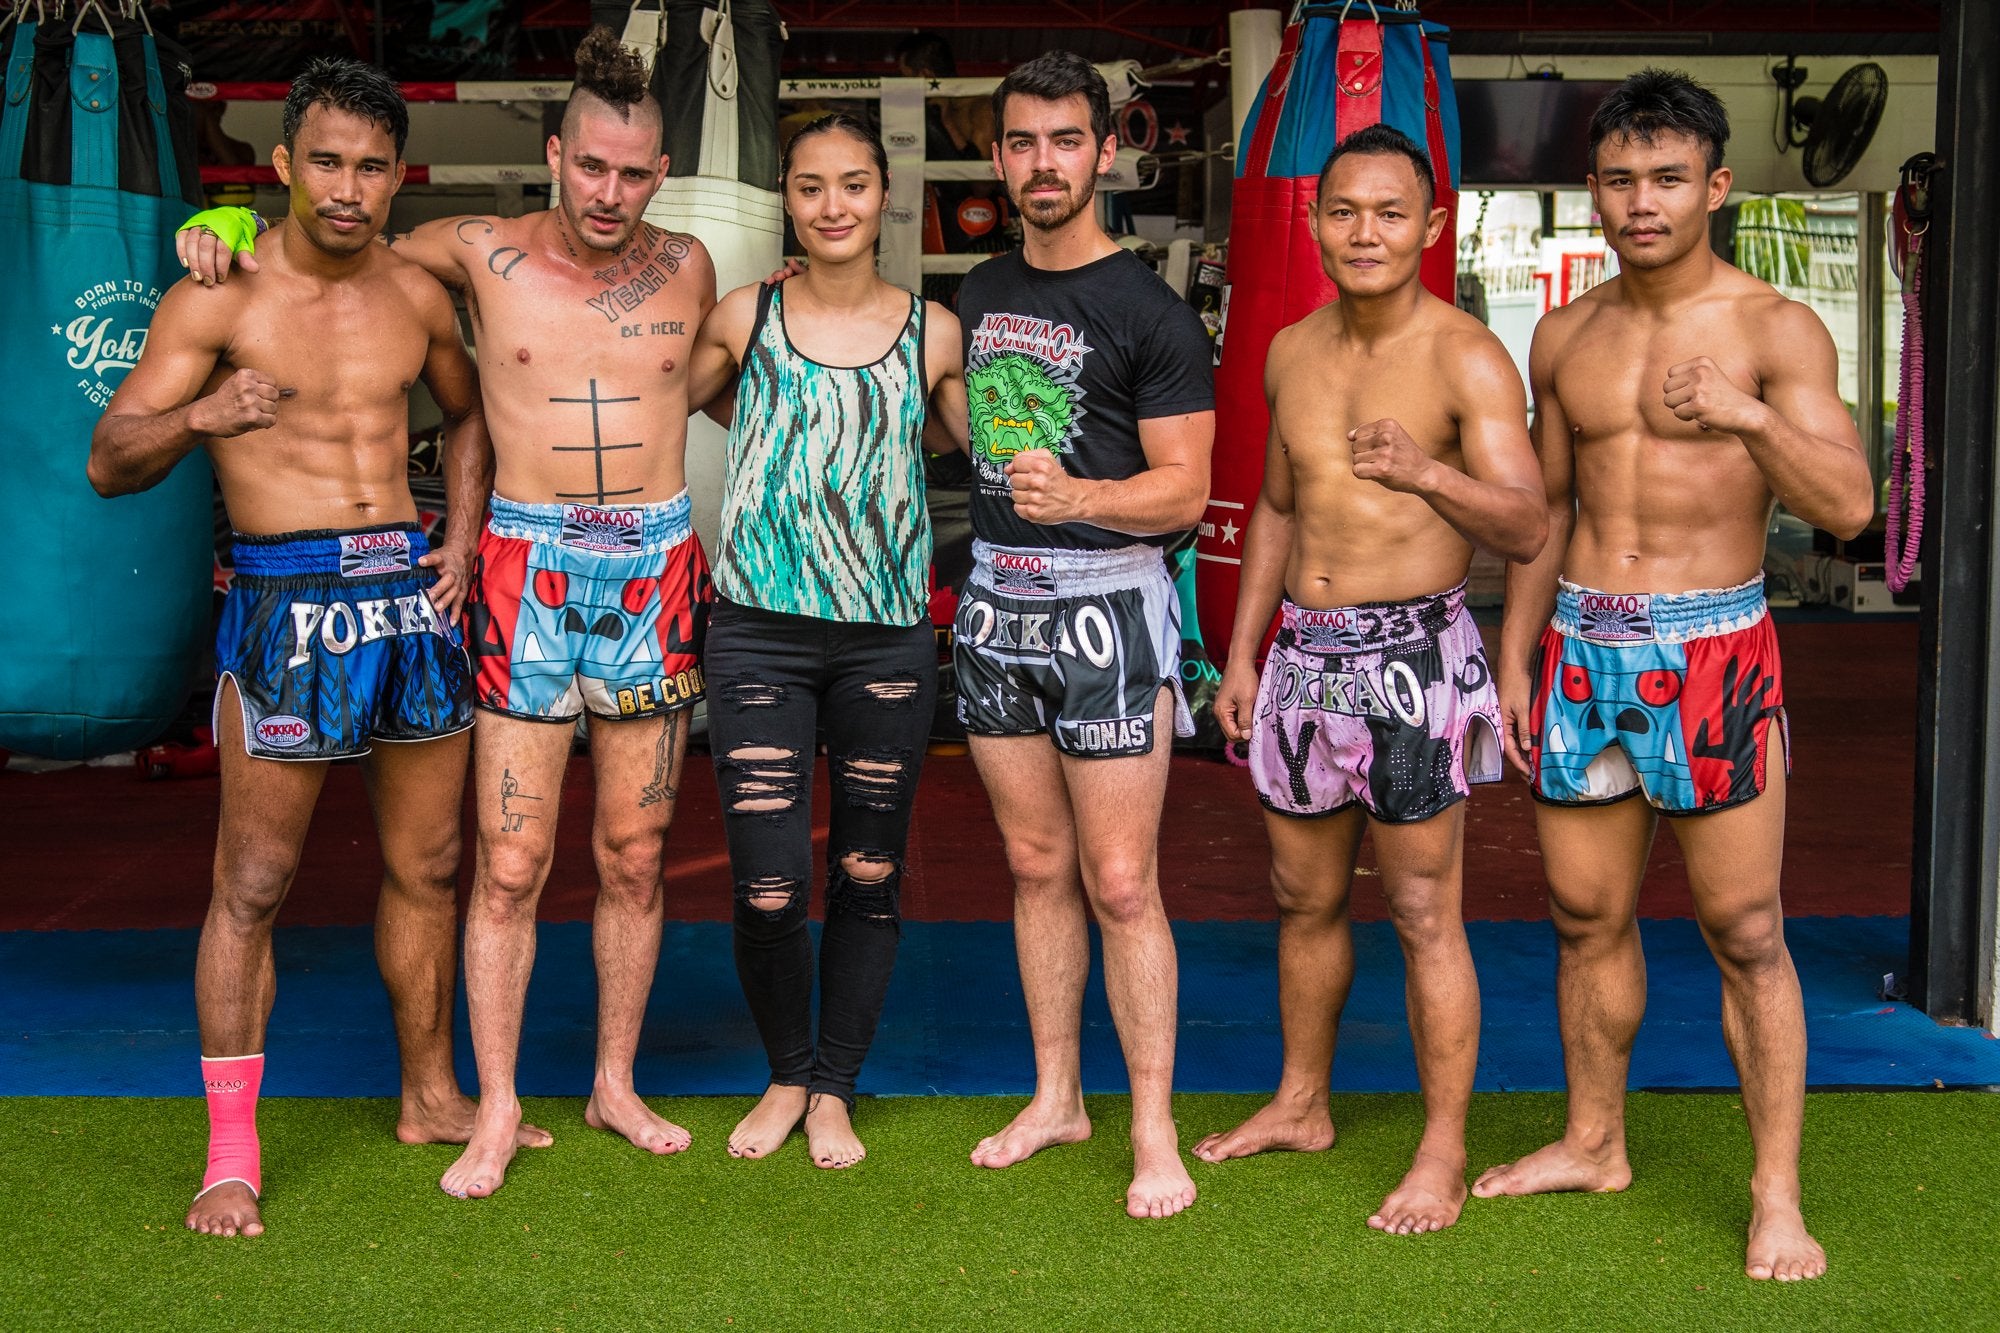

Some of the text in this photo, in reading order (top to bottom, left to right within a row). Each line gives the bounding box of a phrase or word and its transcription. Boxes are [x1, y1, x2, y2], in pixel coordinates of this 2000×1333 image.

[75, 280, 117, 309] BORN
[124, 280, 143, 293] TO
[91, 293, 135, 310] FIGHTER
[586, 264, 668, 323] YEAH
[621, 321, 686, 338] BE HERE
[978, 313, 1073, 365] YOKKAO
[573, 506, 634, 528] YOKKAO
[350, 532, 404, 552] YOKKAO
[572, 540, 632, 551] www.yokkao.com
[352, 565, 403, 576] www.yokkao.com
[995, 552, 1042, 574] YOKKAO
[1584, 594, 1638, 615] YOKKAO
[1301, 610, 1346, 630] YOKKAO
[617, 683, 656, 715] BE
[1261, 651, 1426, 728] YOKKAO
[262, 722, 303, 738] YOKKAO
[1073, 720, 1147, 751] JONAS
[205, 1079, 242, 1089] KKAO
